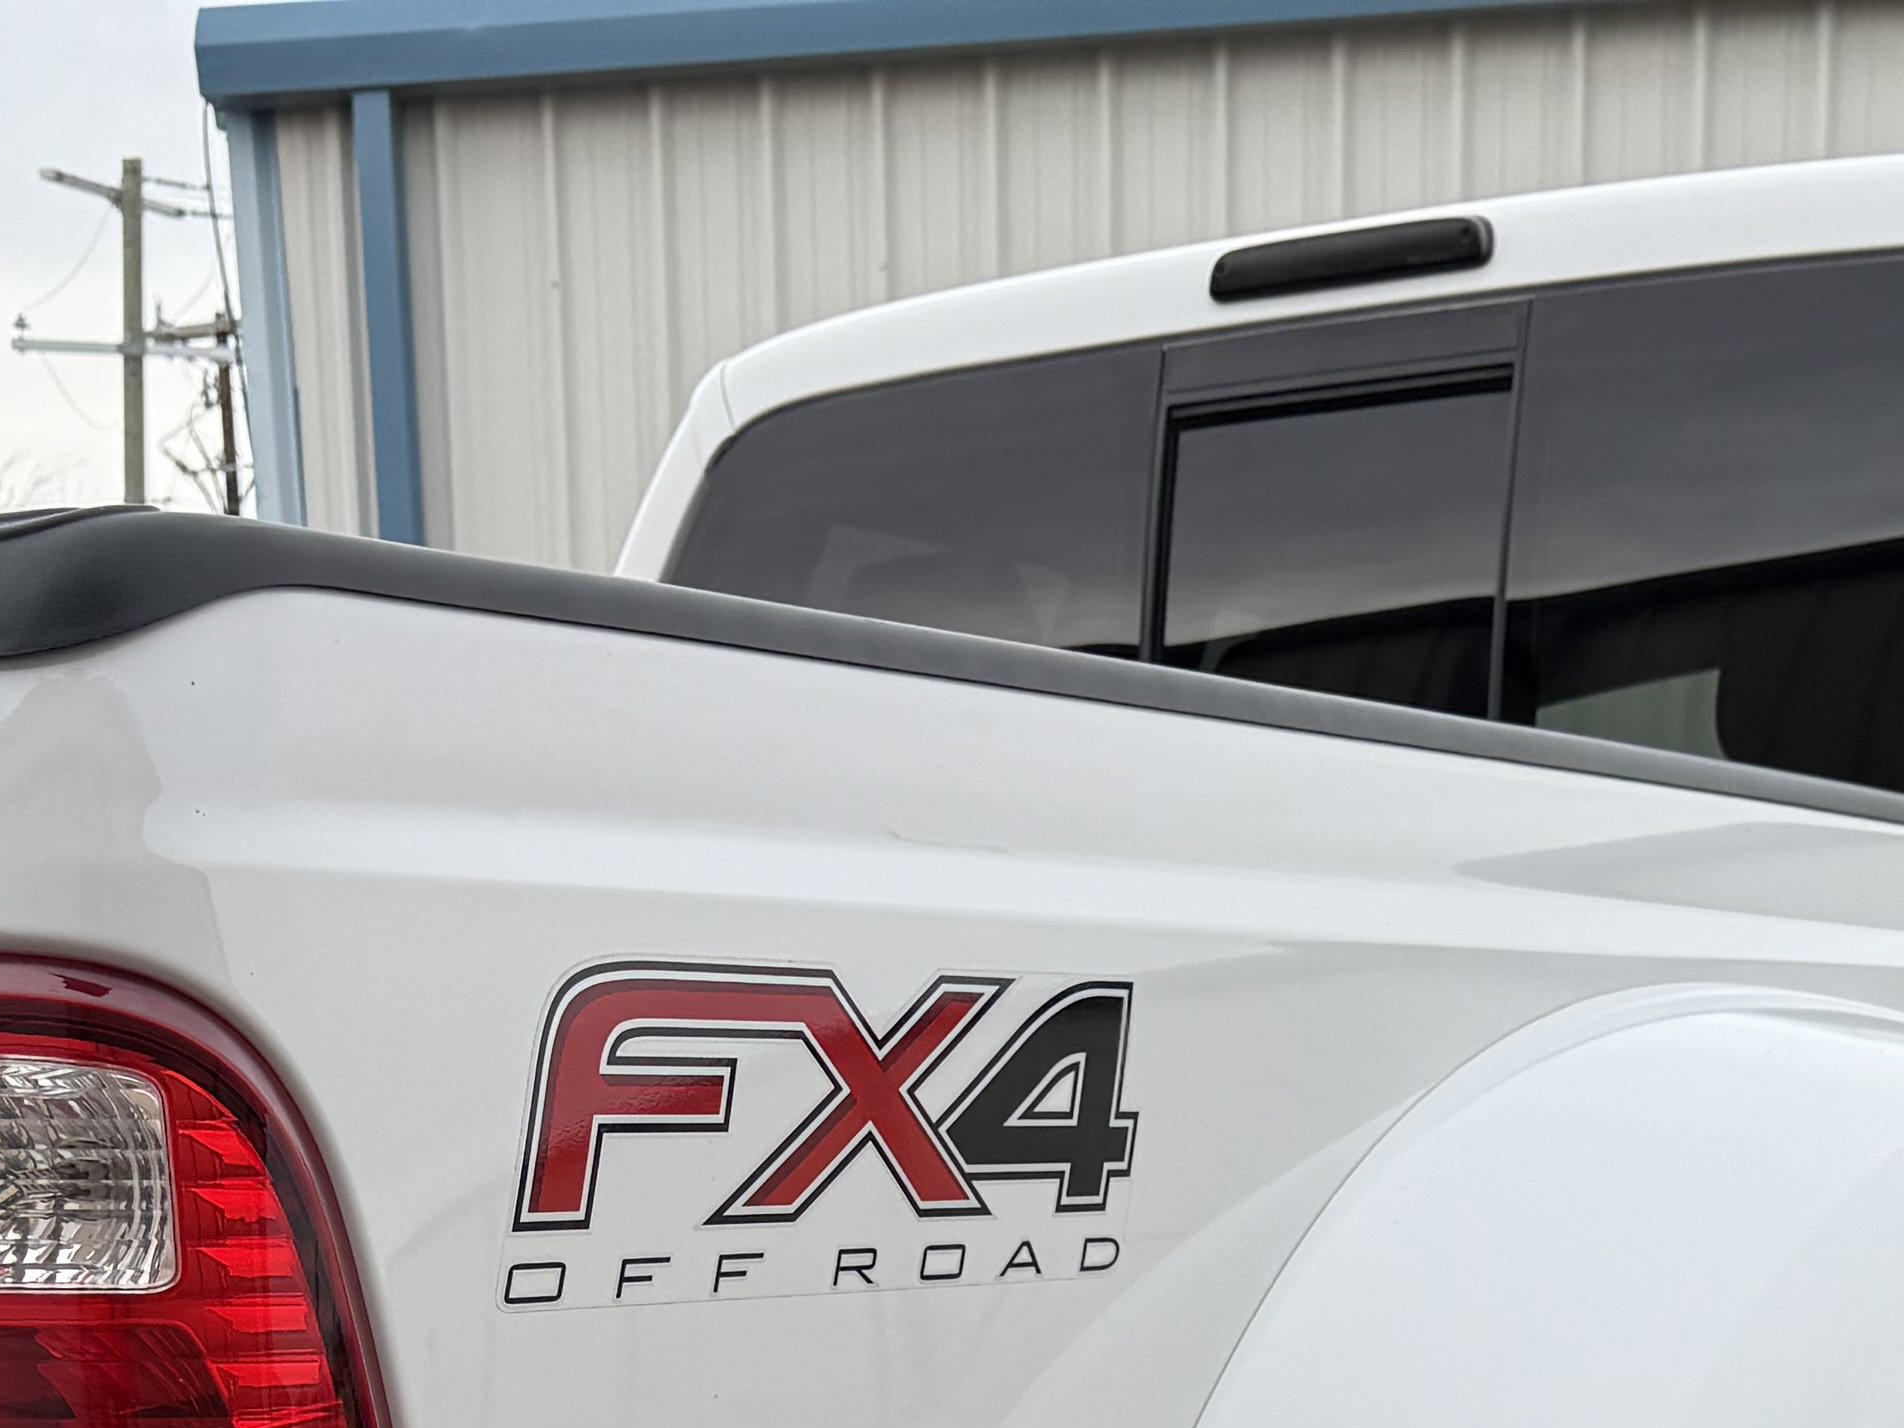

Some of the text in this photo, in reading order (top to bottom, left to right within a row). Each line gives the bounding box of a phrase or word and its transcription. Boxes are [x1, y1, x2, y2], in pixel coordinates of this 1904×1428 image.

[511, 959, 1139, 1233] FX4
[504, 1236, 1120, 1304] OFF ROAD
